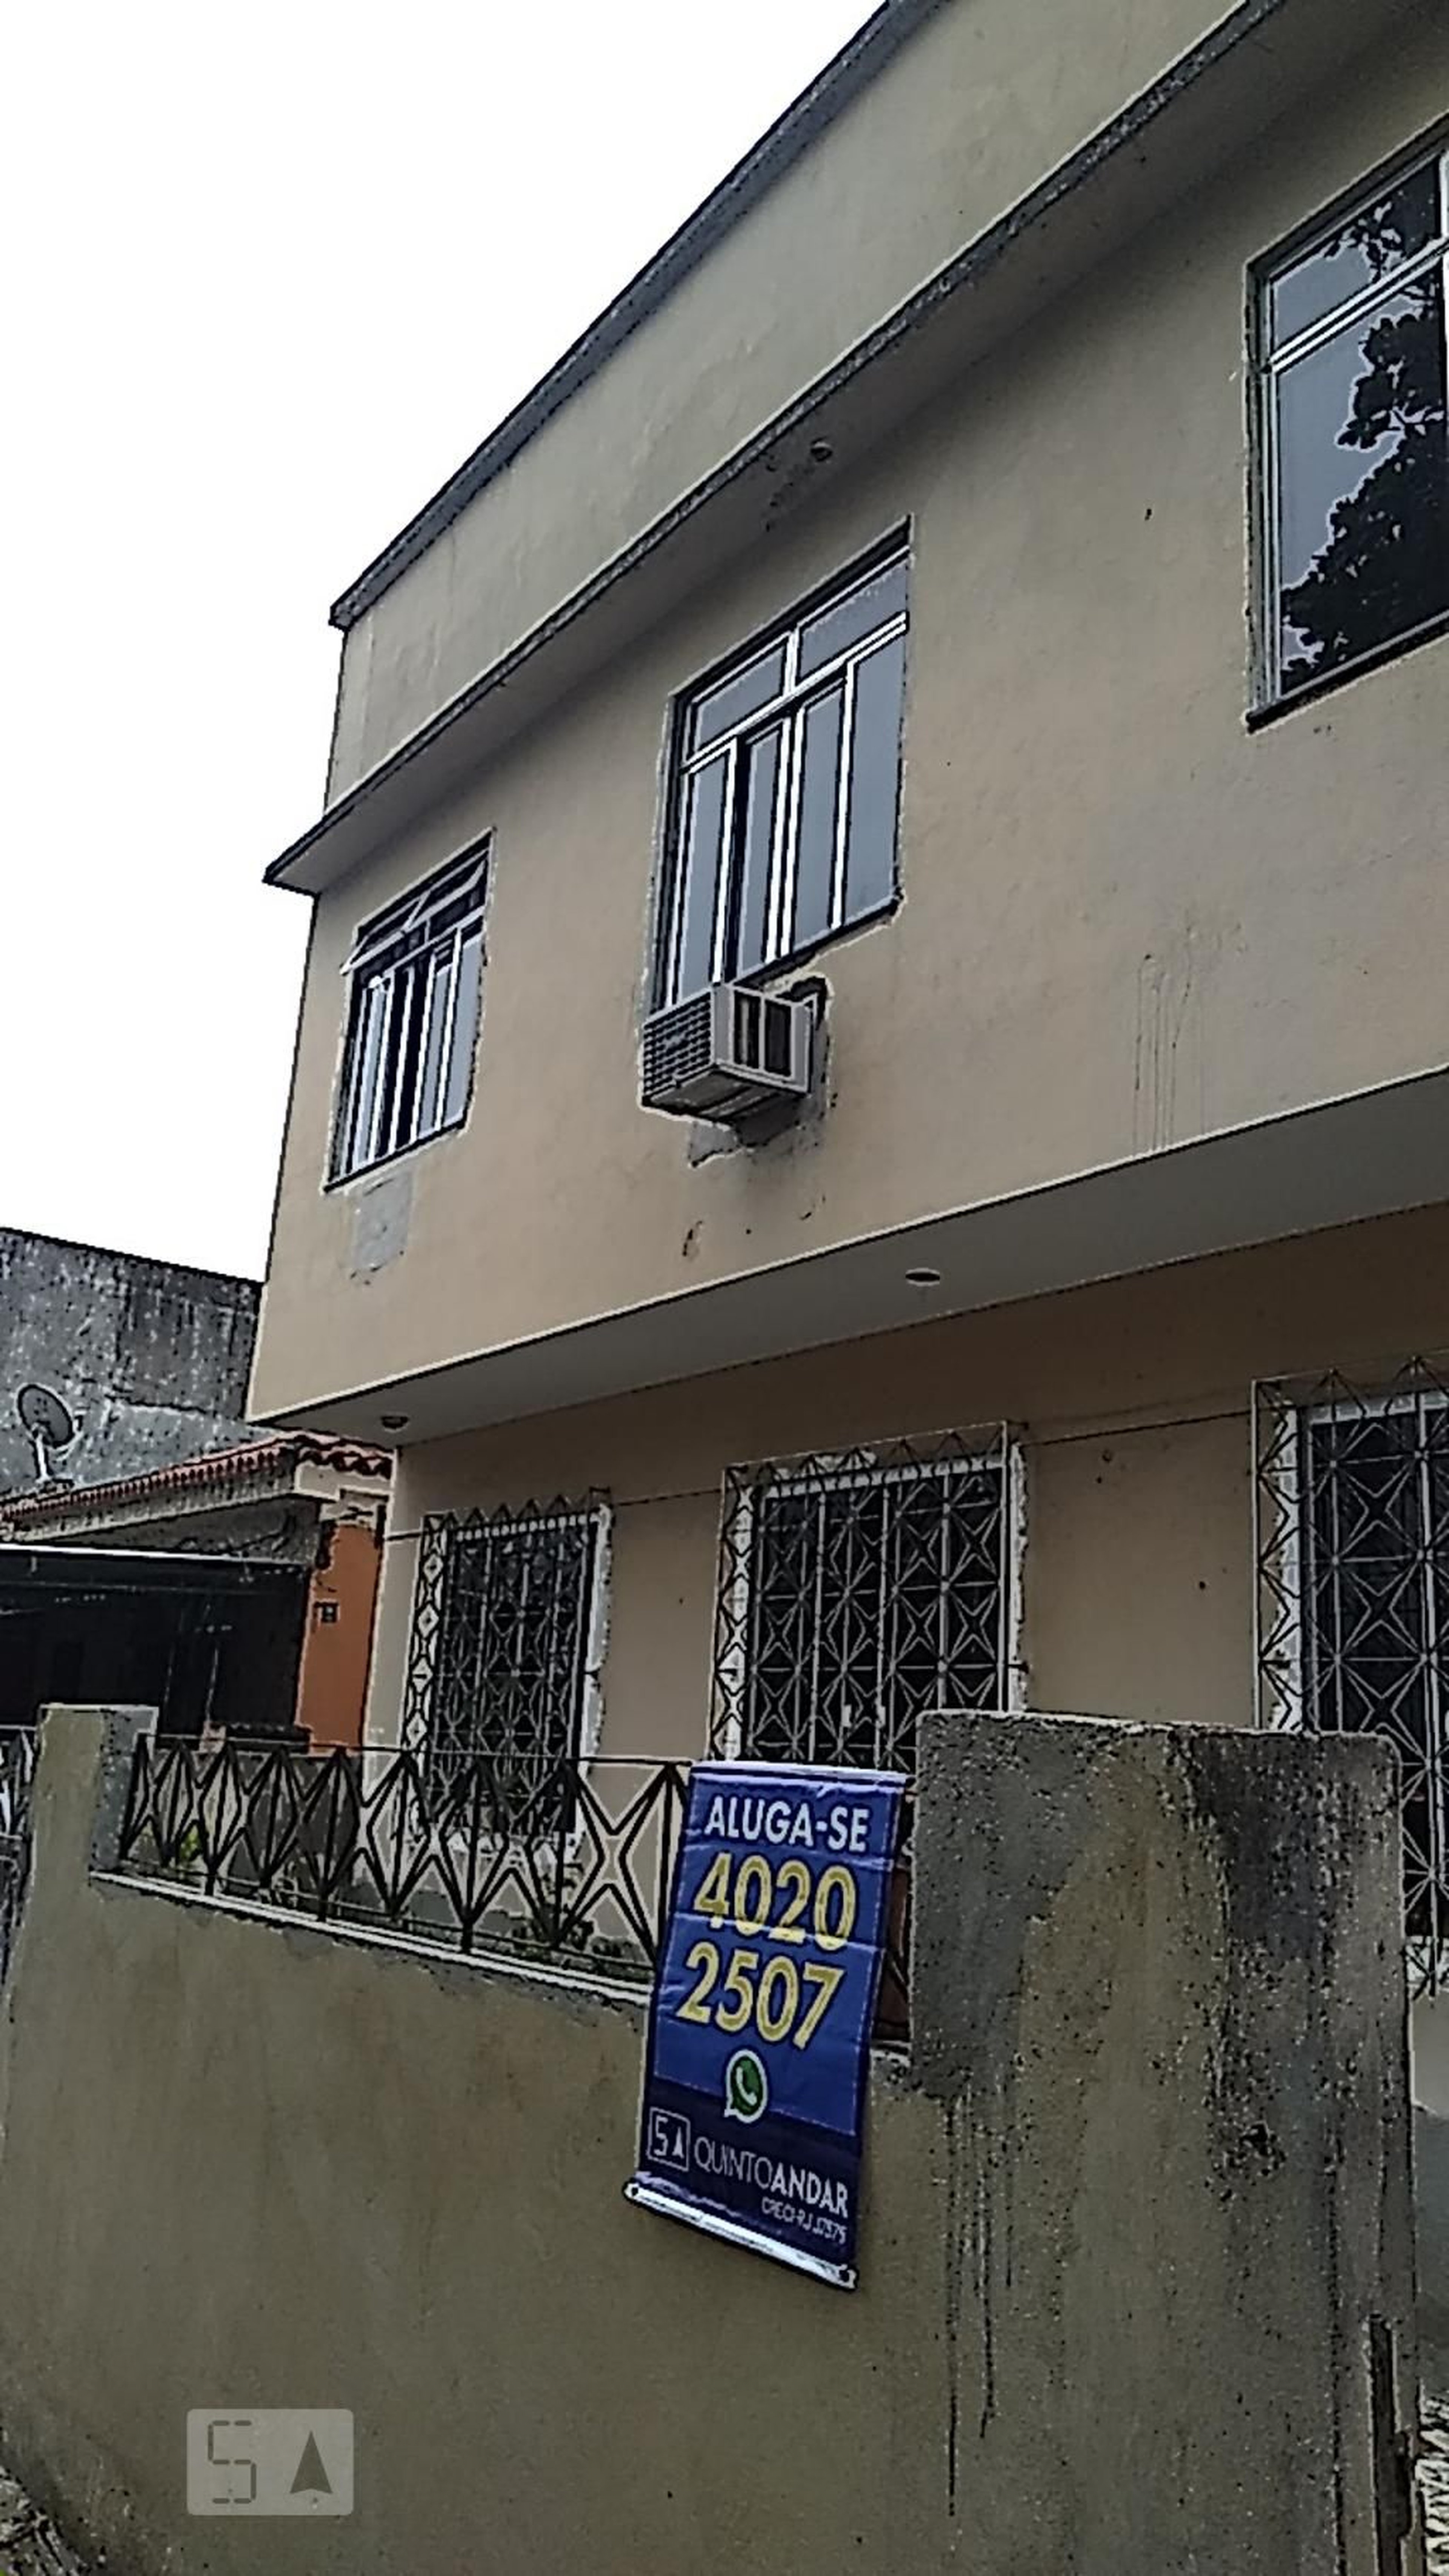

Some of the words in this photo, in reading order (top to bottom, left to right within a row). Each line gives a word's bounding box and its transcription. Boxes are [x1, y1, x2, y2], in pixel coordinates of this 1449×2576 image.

[705, 1796, 870, 1852] ALUGA-SE
[694, 1852, 856, 1950] 4020
[676, 1942, 845, 2049] 2507
[694, 2136, 848, 2218] QUINTOANDAR
